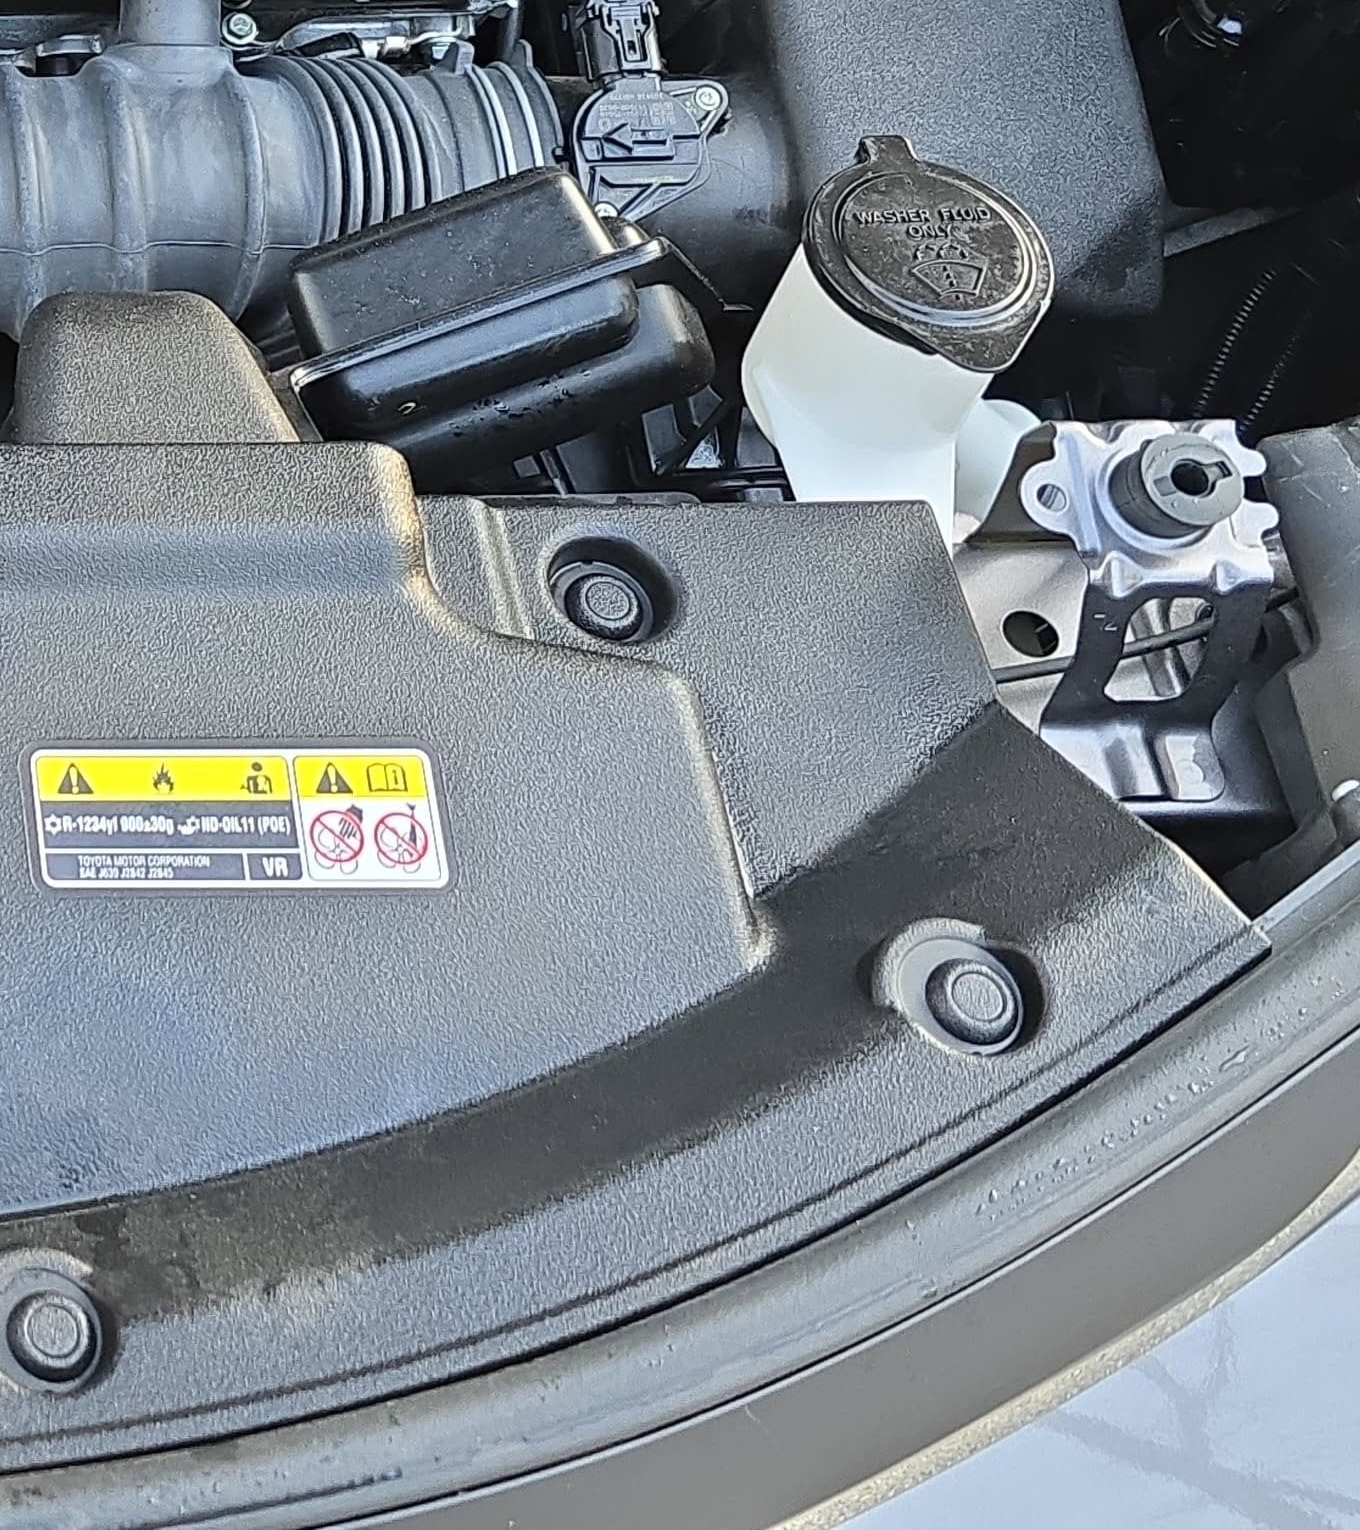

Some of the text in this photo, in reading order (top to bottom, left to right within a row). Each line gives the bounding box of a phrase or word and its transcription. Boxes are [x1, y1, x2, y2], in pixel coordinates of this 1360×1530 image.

[855, 206, 992, 226] WASHER FLUID
[907, 224, 954, 241] ONLY
[257, 815, 291, 836] (POE)
[77, 855, 210, 868] TOYOTA MOTOR CORPORATION
[262, 856, 289, 878] VR
